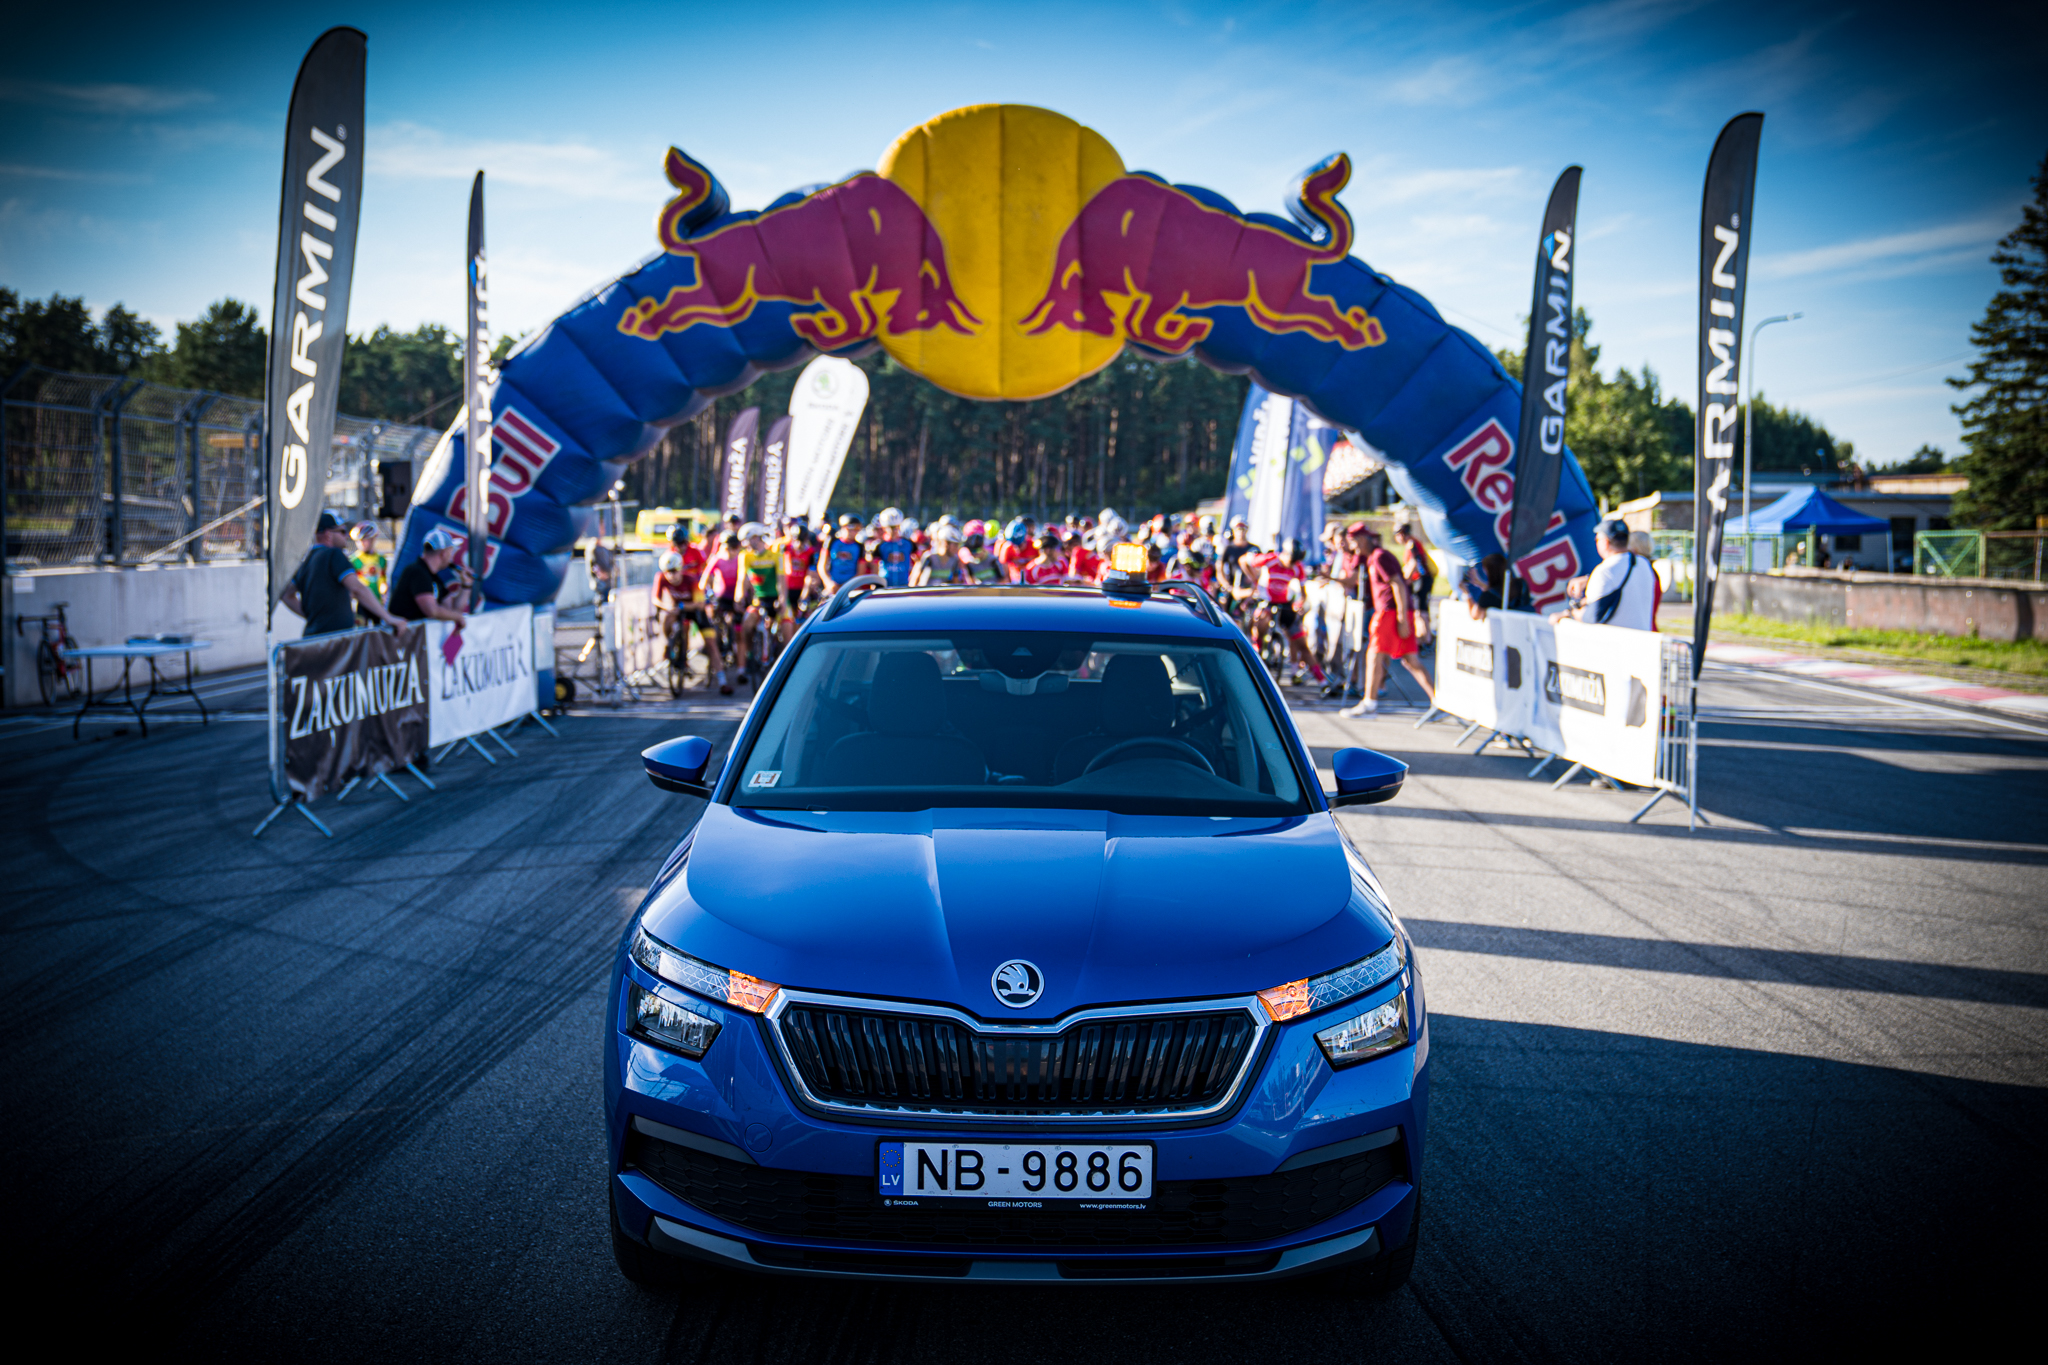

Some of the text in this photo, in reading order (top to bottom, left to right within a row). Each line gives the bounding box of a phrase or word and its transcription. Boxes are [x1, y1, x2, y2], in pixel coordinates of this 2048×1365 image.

[279, 126, 346, 509] GARMIN
[1540, 229, 1571, 455] GARMIN
[290, 648, 425, 747] ZAĶUMUIŽA
[882, 1174, 900, 1186] LV
